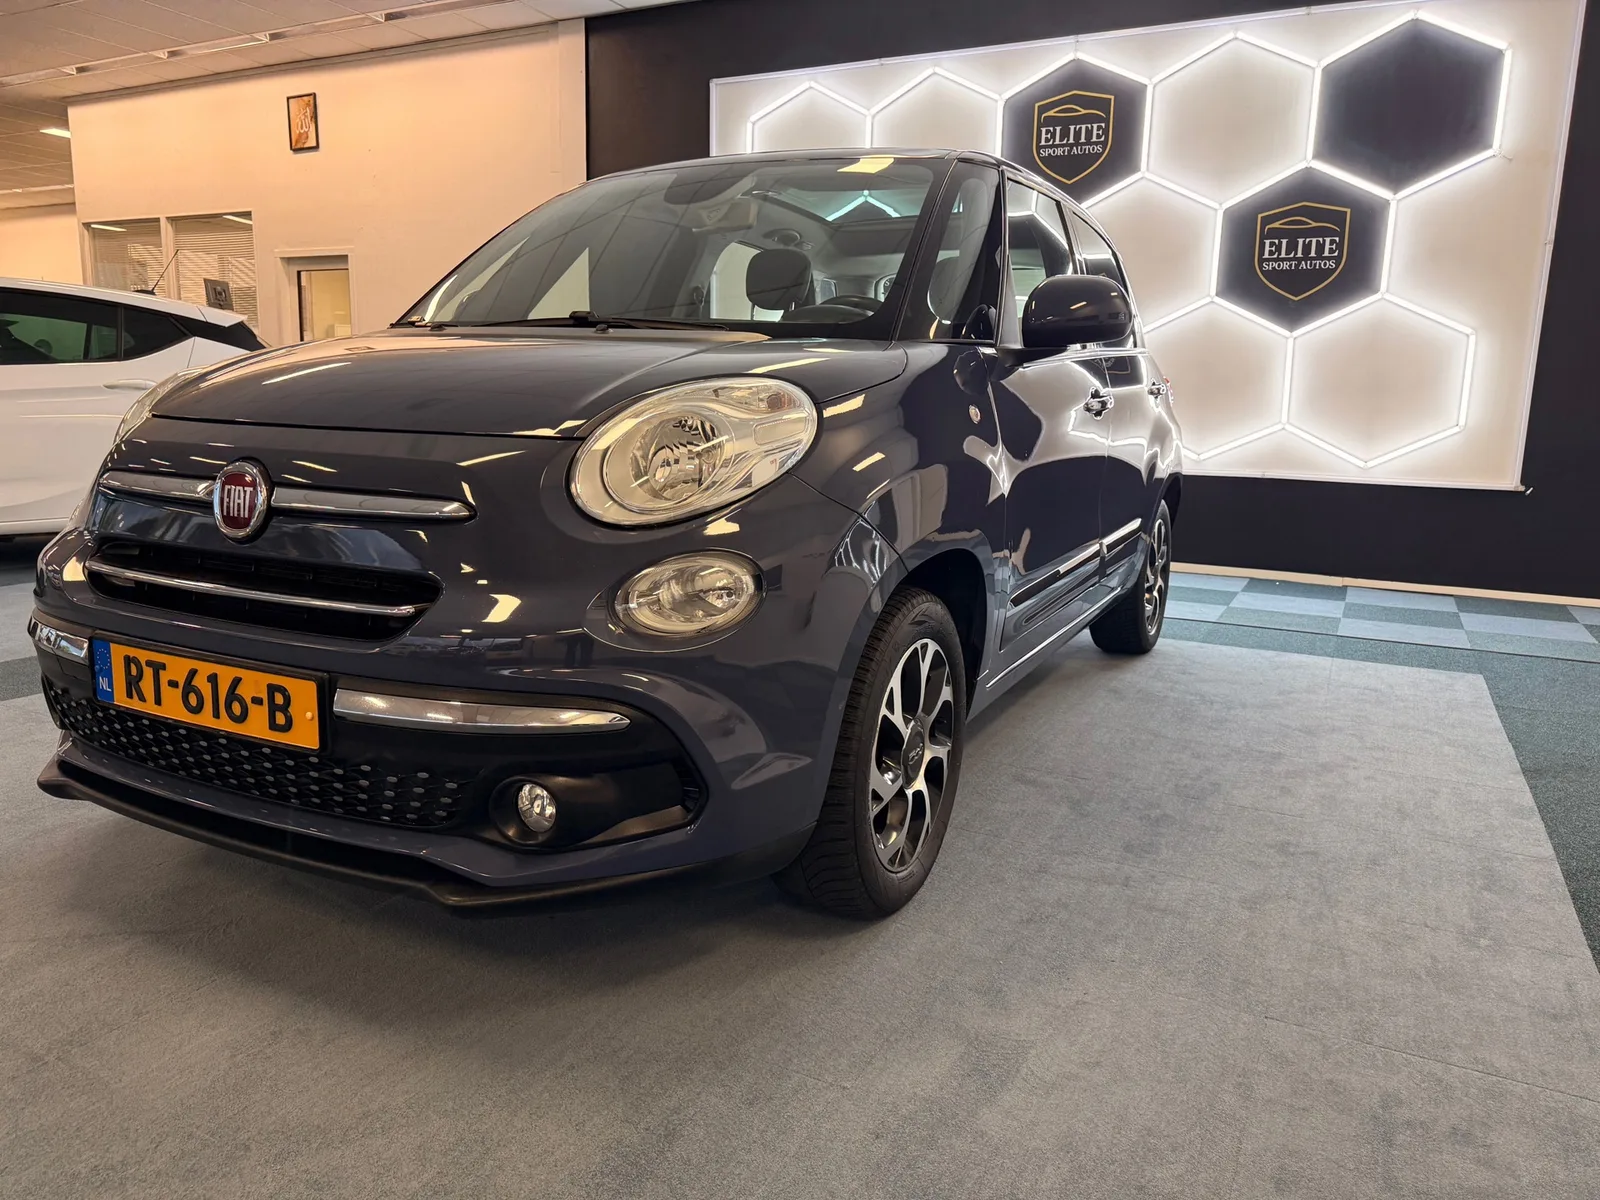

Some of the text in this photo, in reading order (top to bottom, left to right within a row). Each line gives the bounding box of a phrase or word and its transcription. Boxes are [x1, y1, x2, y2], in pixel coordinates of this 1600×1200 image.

[1039, 123, 1105, 145] ELITE
[1039, 145, 1103, 157] SPORT AUTOS
[1262, 237, 1340, 258] ELITE
[1262, 260, 1336, 270] SPORT AUTOS
[223, 485, 254, 518] FIAT
[99, 676, 112, 692] NL
[123, 654, 294, 734] RT-616-B
